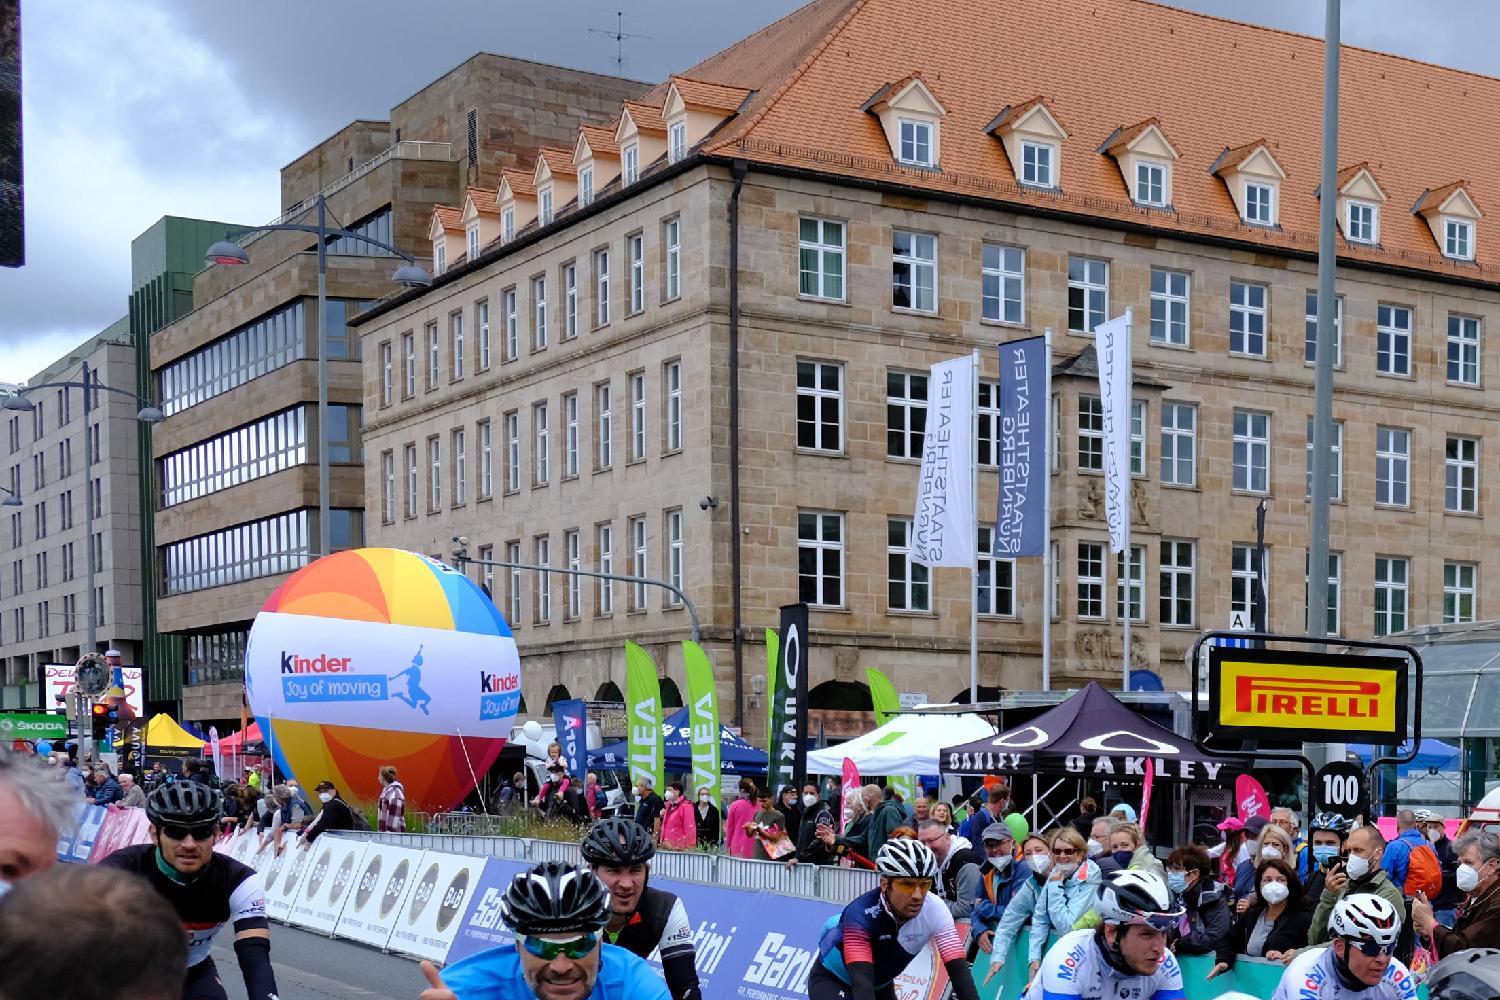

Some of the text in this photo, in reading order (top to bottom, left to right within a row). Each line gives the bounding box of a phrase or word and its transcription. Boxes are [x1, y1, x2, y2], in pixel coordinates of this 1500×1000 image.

[1233, 613, 1244, 629] A
[46, 667, 141, 680] DEUND
[281, 651, 352, 674] kinder
[286, 680, 381, 698] Joy of moving
[481, 671, 519, 693] kinder
[482, 698, 500, 717] Joy
[1236, 676, 1381, 717] PIRELLI
[17, 720, 64, 731] ŠKODA
[950, 752, 1022, 770] OAKLEY
[1065, 754, 1222, 781] OAKLEY
[1322, 774, 1359, 805] 100
[1057, 944, 1086, 981] Mobil
[1158, 953, 1180, 978] obil
